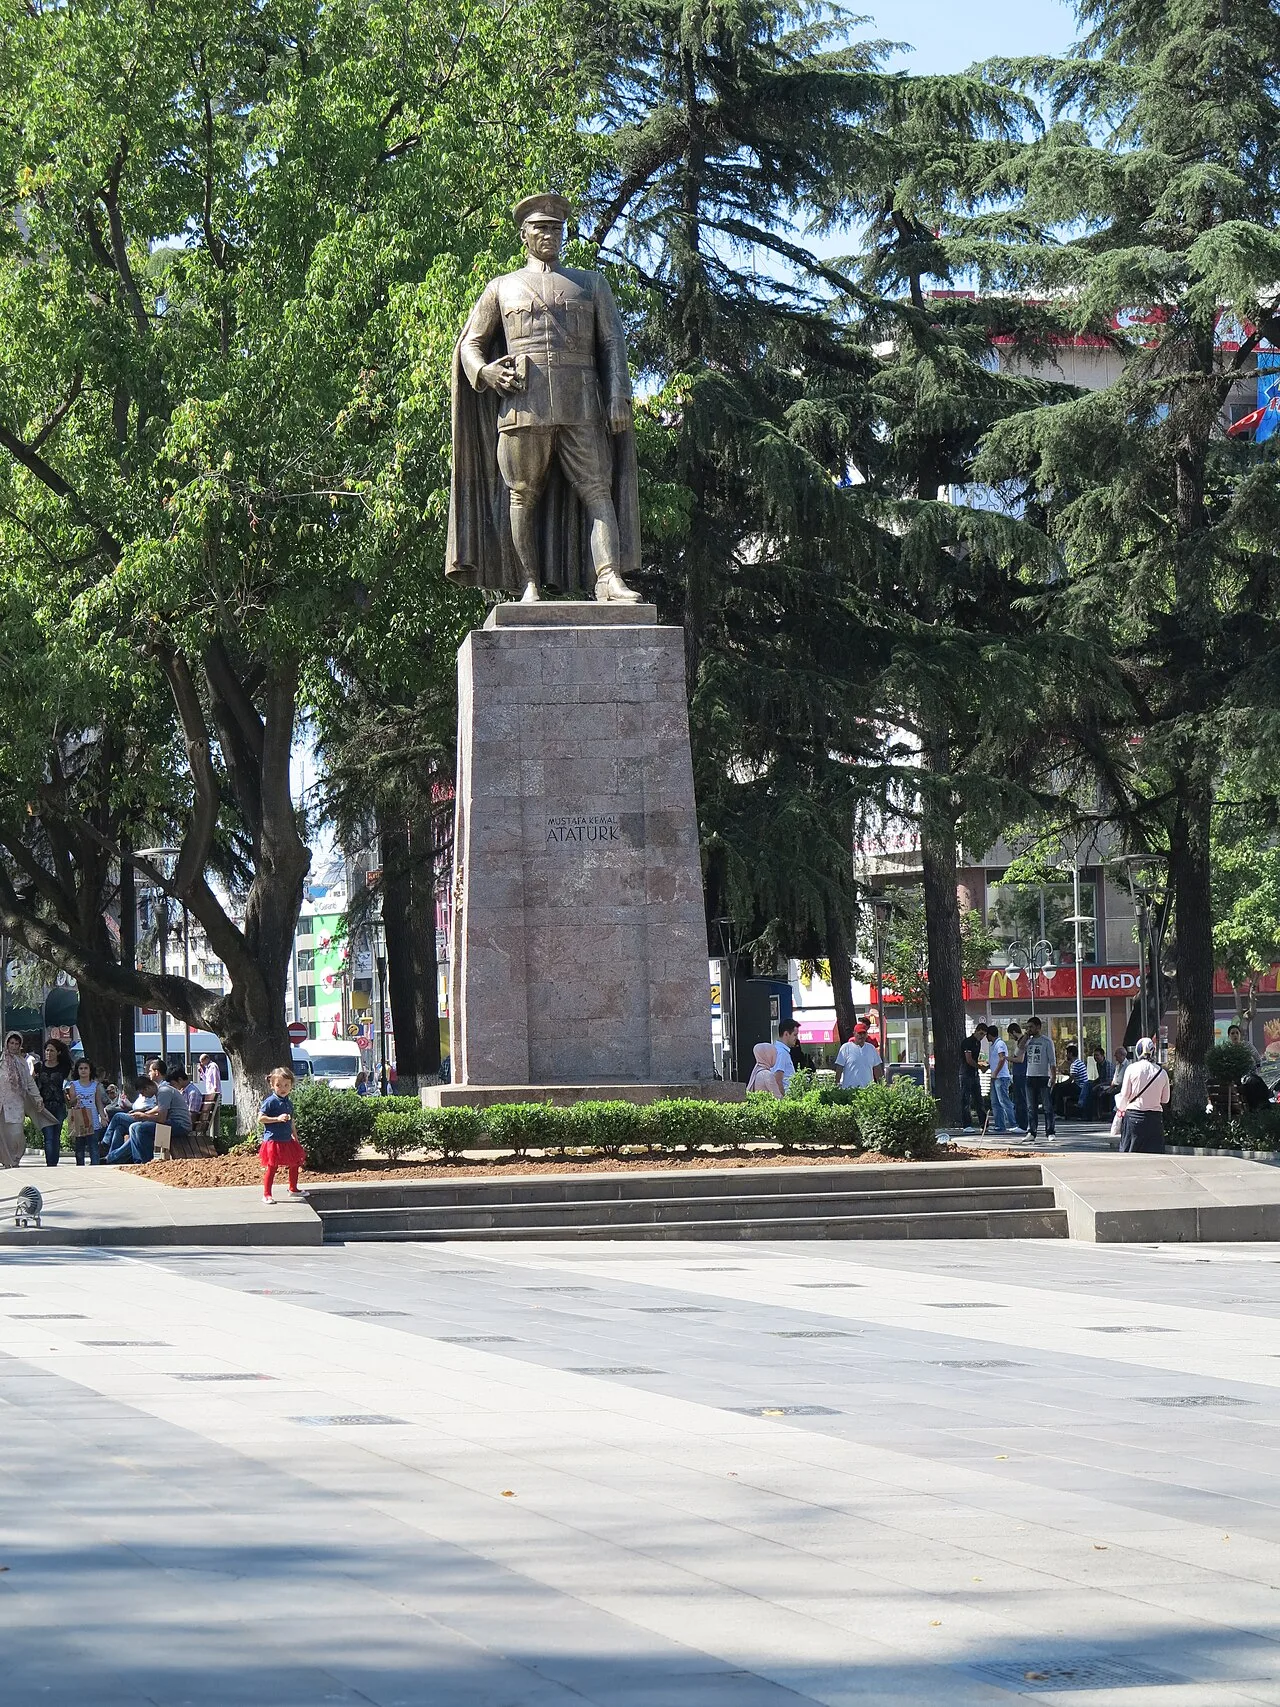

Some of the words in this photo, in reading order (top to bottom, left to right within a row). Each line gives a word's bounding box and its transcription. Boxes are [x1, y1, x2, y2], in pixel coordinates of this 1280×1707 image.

[548, 817, 587, 825] MUSTAFA
[588, 815, 618, 824] KEMAL
[546, 826, 620, 841] ATATÜRK
